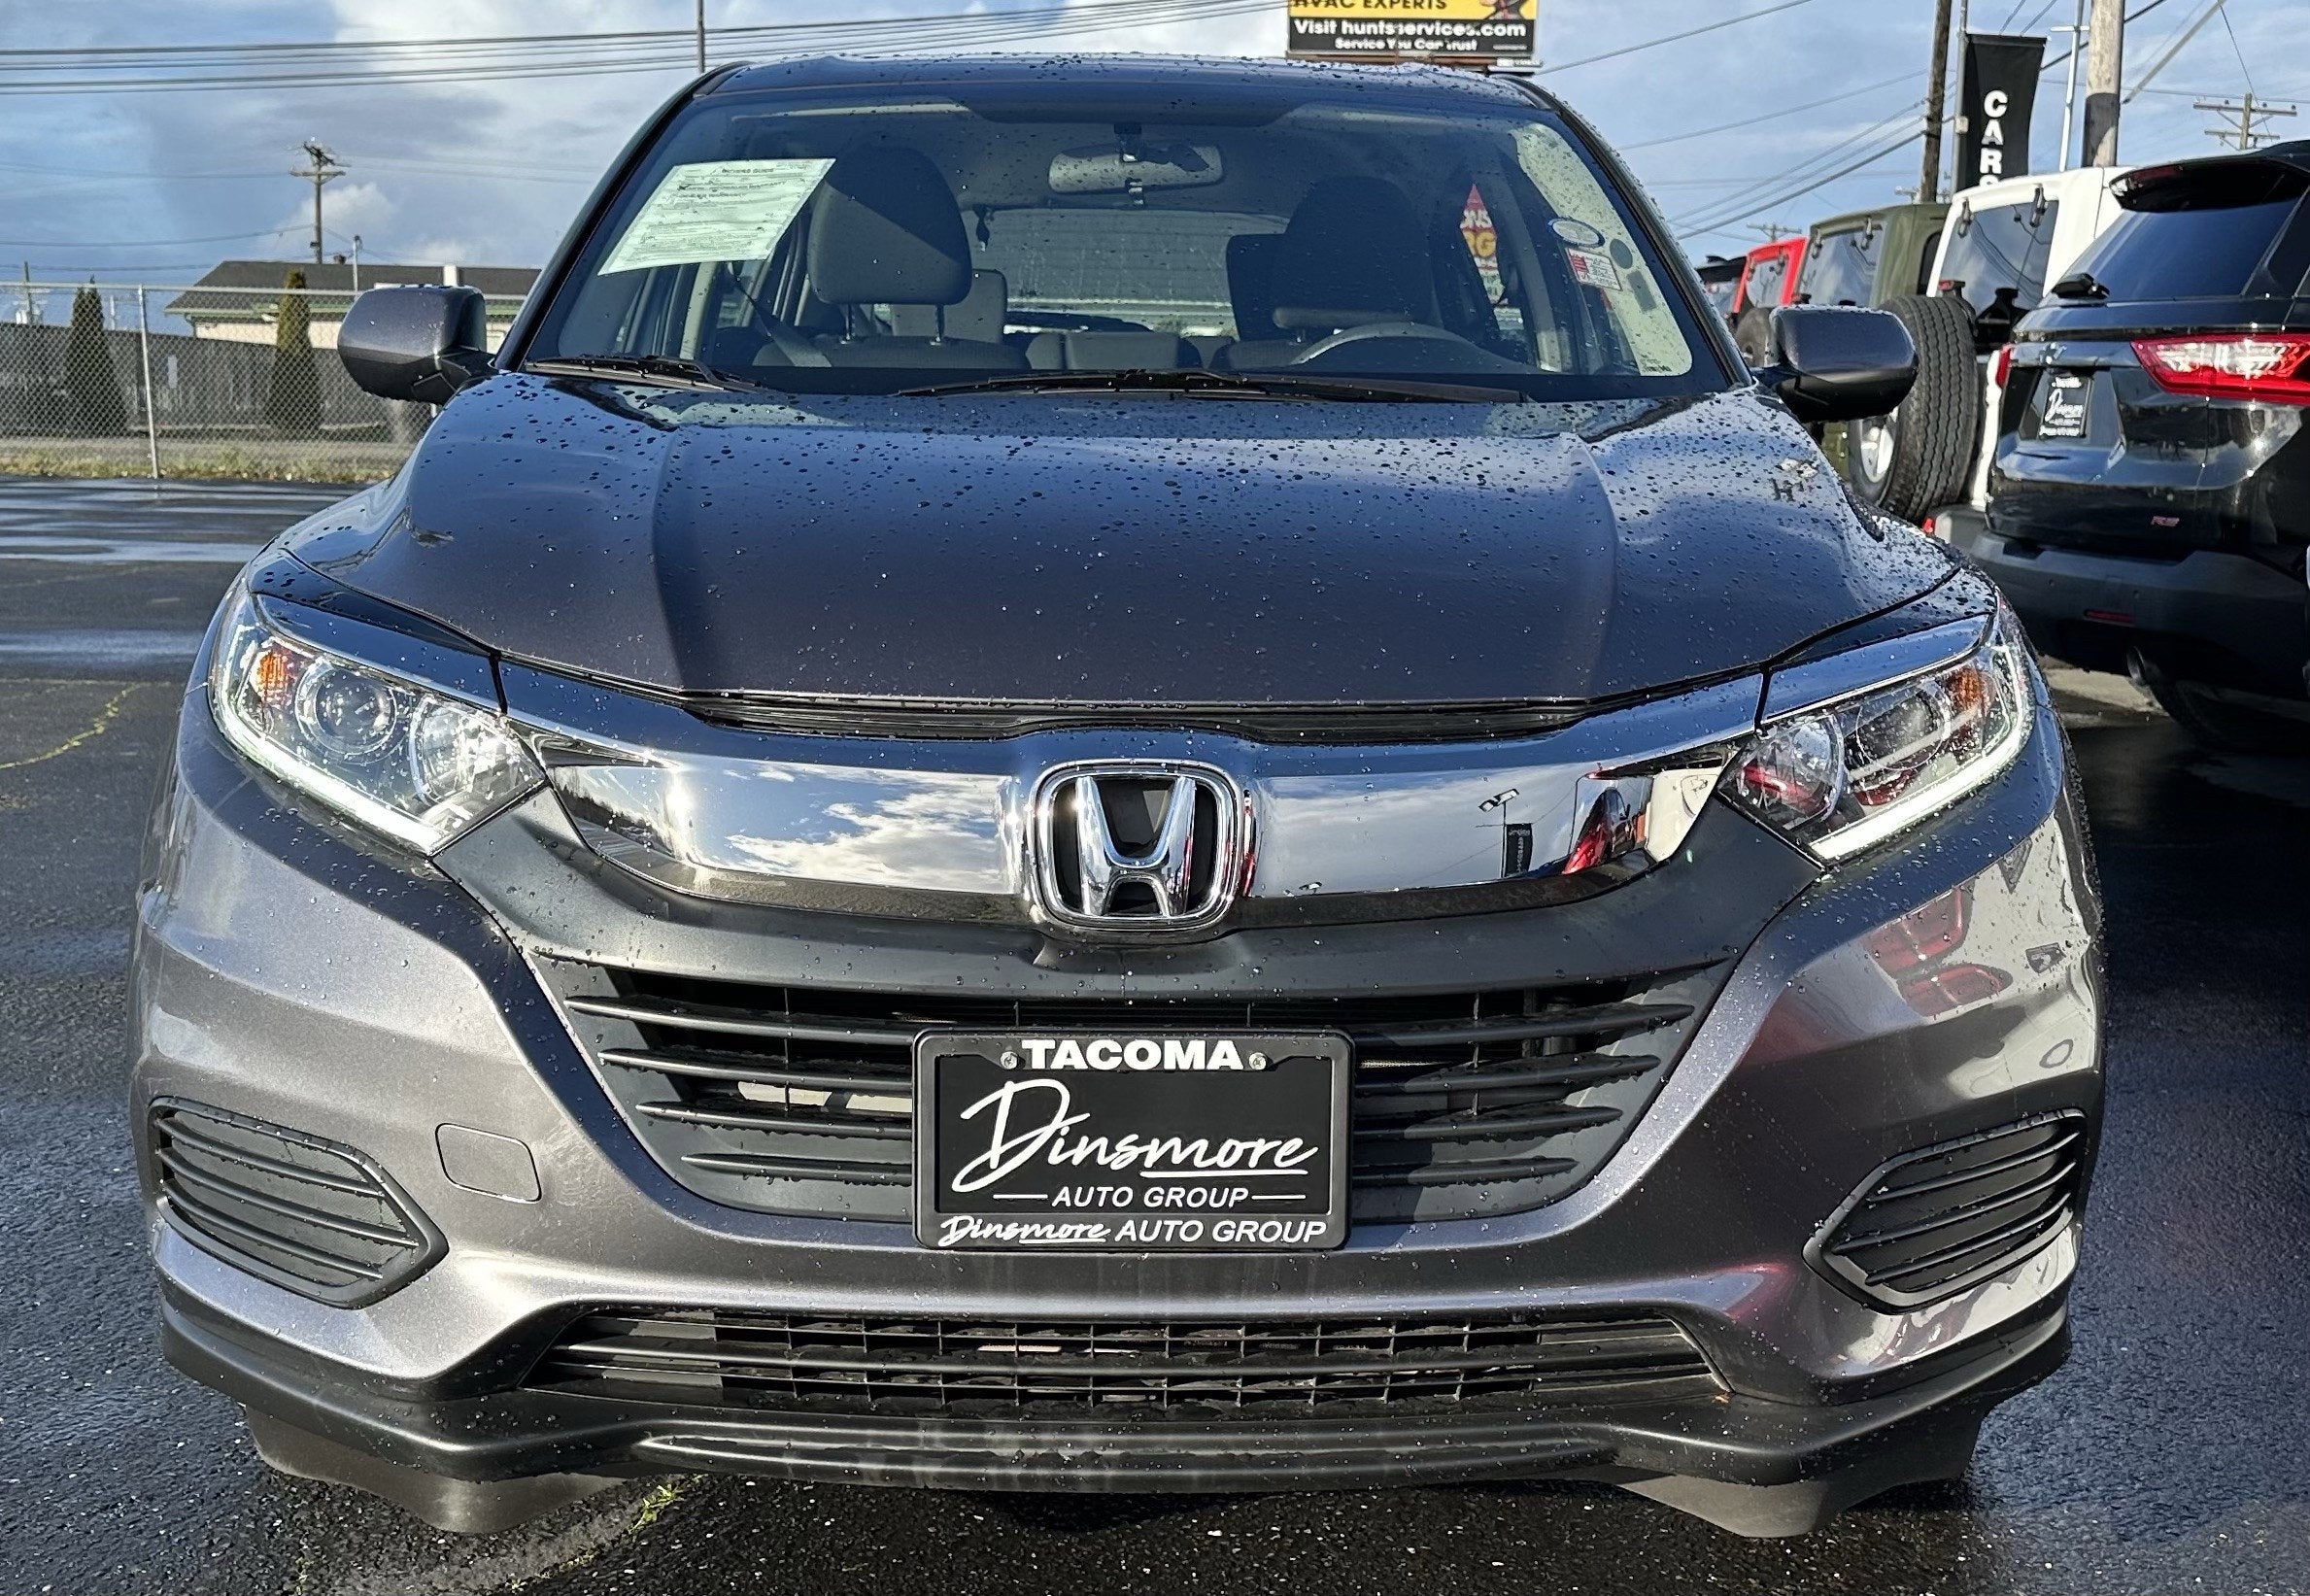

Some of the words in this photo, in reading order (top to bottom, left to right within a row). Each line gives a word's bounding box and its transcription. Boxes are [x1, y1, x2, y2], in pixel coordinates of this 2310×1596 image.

[1294, 19, 1337, 35] Visit
[1021, 1039, 1244, 1070] TACOMA
[951, 1078, 1319, 1193] Dinsmore
[1052, 1186, 1134, 1208] AUTO
[1143, 1186, 1250, 1208] GROUP
[937, 1215, 1111, 1247] Dinsmore
[1115, 1220, 1204, 1242] AUTO
[1211, 1220, 1329, 1243] GROUP
